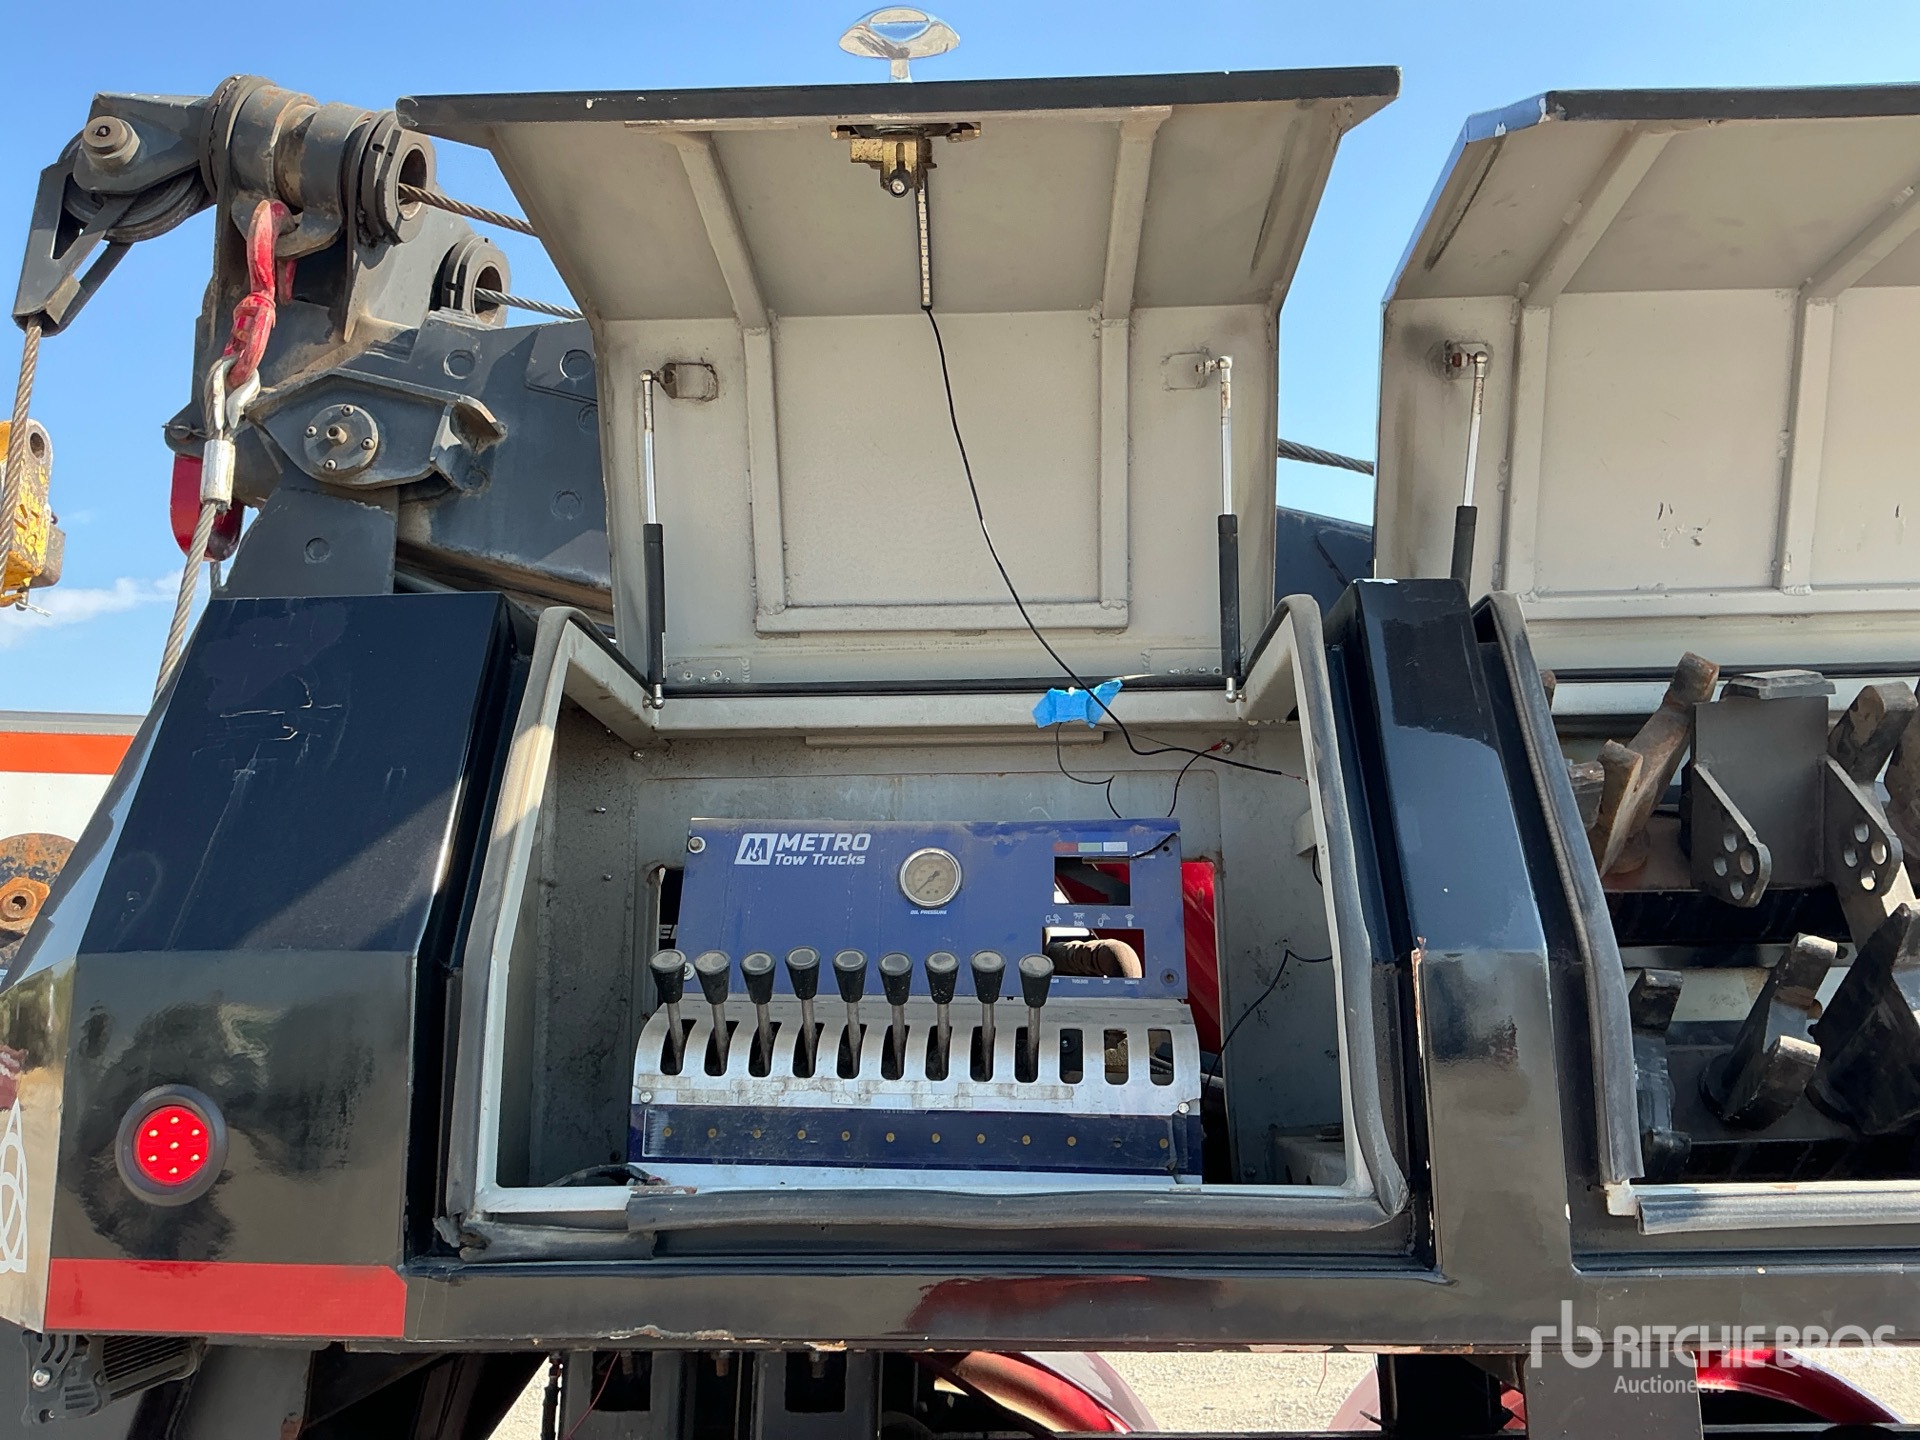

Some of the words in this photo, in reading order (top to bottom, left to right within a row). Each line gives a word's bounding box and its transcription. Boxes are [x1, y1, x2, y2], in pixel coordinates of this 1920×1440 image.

[776, 833, 872, 852] METRO
[775, 853, 807, 866] Tow
[812, 853, 866, 866] Trucks
